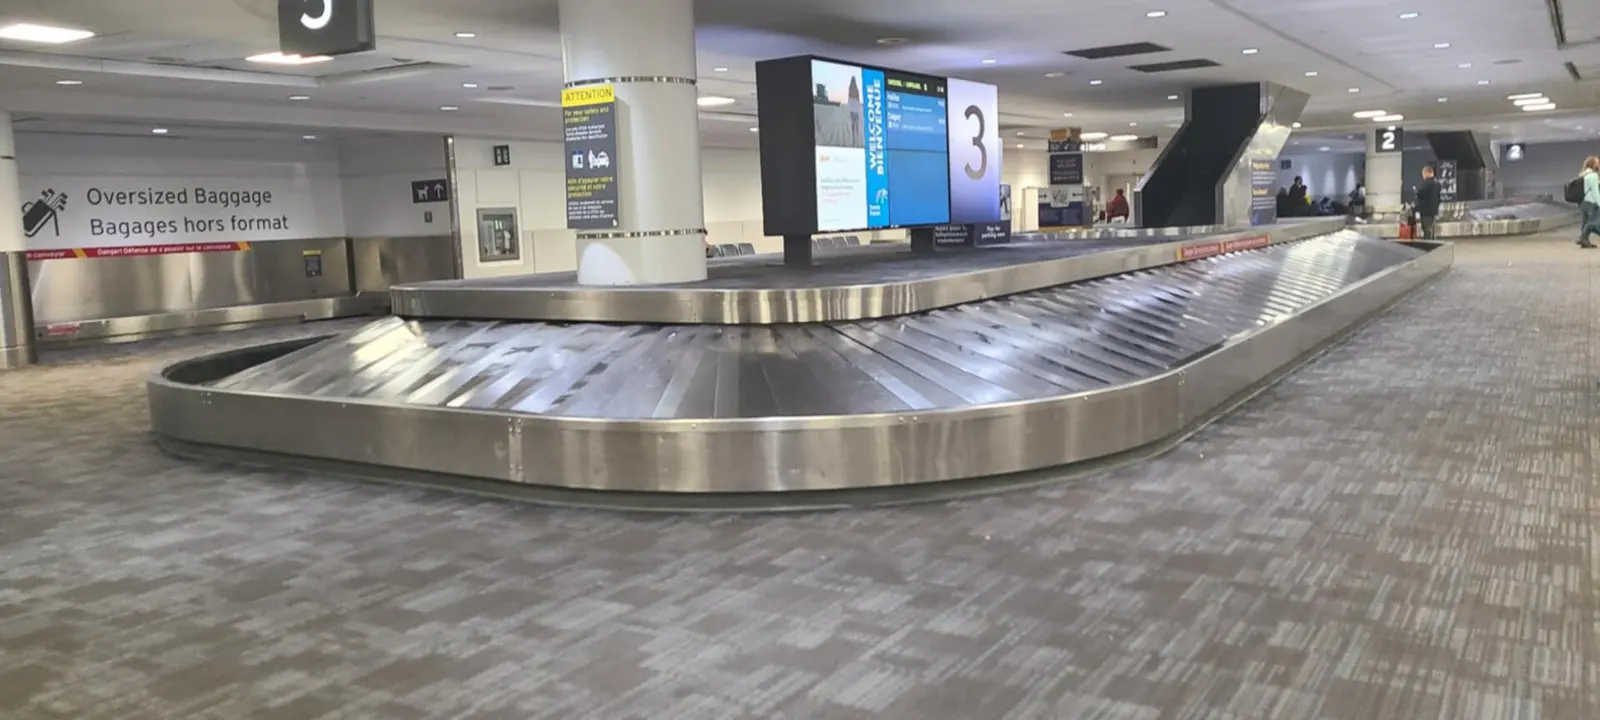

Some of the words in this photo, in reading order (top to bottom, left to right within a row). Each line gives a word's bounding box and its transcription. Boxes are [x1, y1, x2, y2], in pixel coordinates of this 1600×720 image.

[565, 87, 612, 101] ATTENTION
[866, 84, 878, 169] WELCOME
[873, 79, 885, 175] BIENVENUE
[964, 105, 987, 180] 3
[1382, 131, 1395, 150] 2
[1510, 145, 1520, 159] 2
[87, 187, 188, 206] Oversized
[195, 187, 272, 208] Baggage
[90, 218, 177, 239] Bagages
[184, 216, 225, 233] hors
[231, 214, 289, 232] format
[123, 247, 149, 255] Défense
